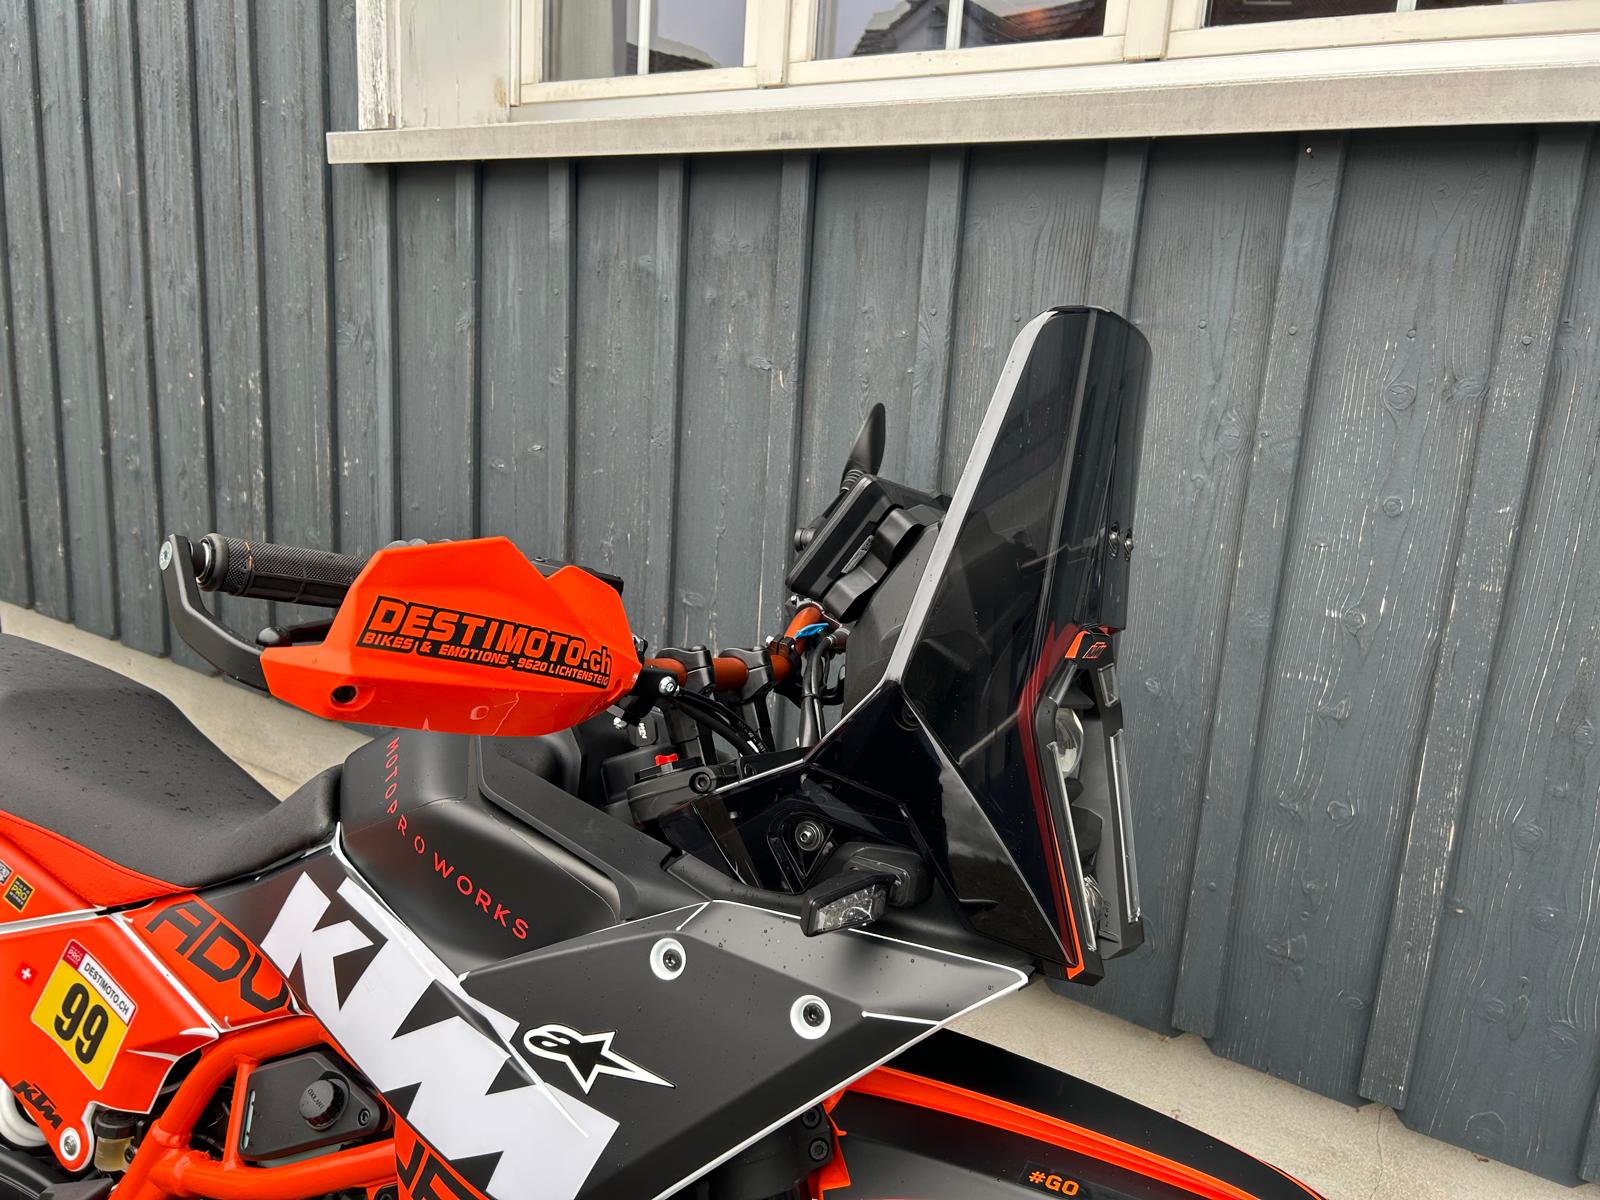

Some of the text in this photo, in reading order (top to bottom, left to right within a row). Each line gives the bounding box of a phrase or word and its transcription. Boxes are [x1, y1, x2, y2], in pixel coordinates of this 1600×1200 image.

[362, 632, 413, 650] BIKES
[419, 640, 432, 653] &
[438, 644, 508, 665] EMOTIONS
[516, 658, 548, 673] 9620
[548, 661, 610, 686] LICHTENSTEIG
[367, 599, 612, 676] DESTIMOTO.ch
[11, 884, 28, 901] PRO
[84, 962, 129, 1015] DESTIMOTO.CH
[54, 982, 110, 1065] 99
[259, 871, 620, 1200] KTM
[12, 1080, 64, 1130] KTM
[1028, 1170, 1080, 1196] #GO
